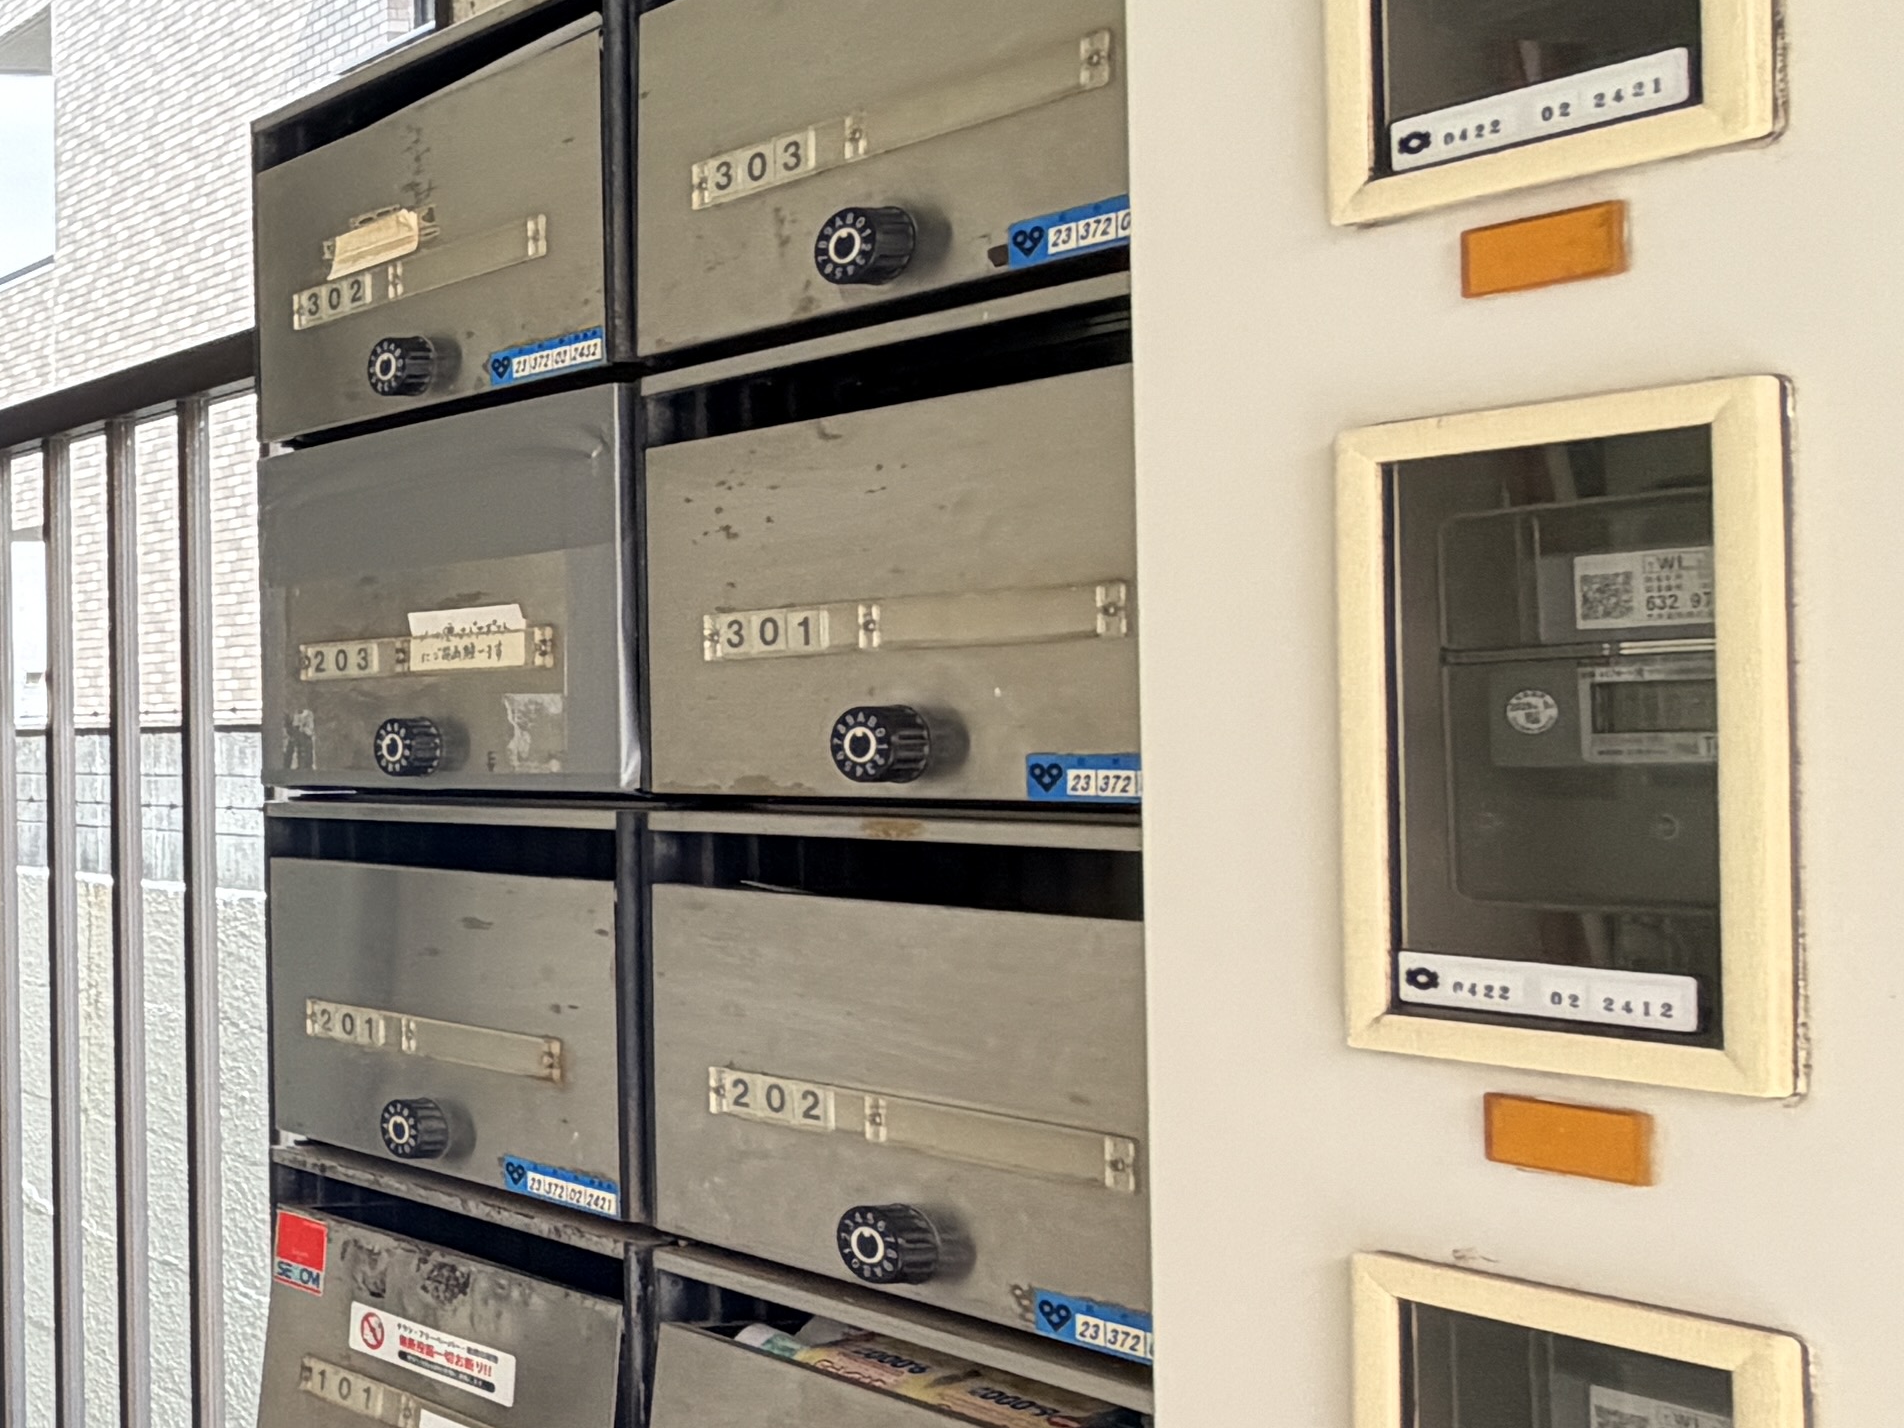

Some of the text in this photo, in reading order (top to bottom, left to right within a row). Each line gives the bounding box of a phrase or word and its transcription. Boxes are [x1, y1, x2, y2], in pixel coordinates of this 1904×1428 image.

[1541, 102, 1571, 122] 02
[1593, 77, 1662, 108] 2421
[715, 140, 802, 191] 303
[1051, 226, 1073, 248] 23
[1080, 217, 1113, 240] 372
[307, 279, 363, 317] 302
[514, 358, 528, 374] 23
[531, 353, 551, 370] 372
[1646, 594, 1680, 611] 632
[726, 616, 810, 648] 301
[314, 647, 369, 673] 203
[1070, 774, 1132, 794] 23 372
[1550, 991, 1581, 1008] 02
[1603, 997, 1674, 1019] 2412
[320, 1008, 372, 1040] 201
[732, 1078, 821, 1121] 202
[529, 1177, 542, 1191] 23
[545, 1182, 565, 1199] 372
[569, 1188, 583, 1204] 02
[1079, 1321, 1141, 1352] 23 372
[318, 1369, 372, 1410] 101
